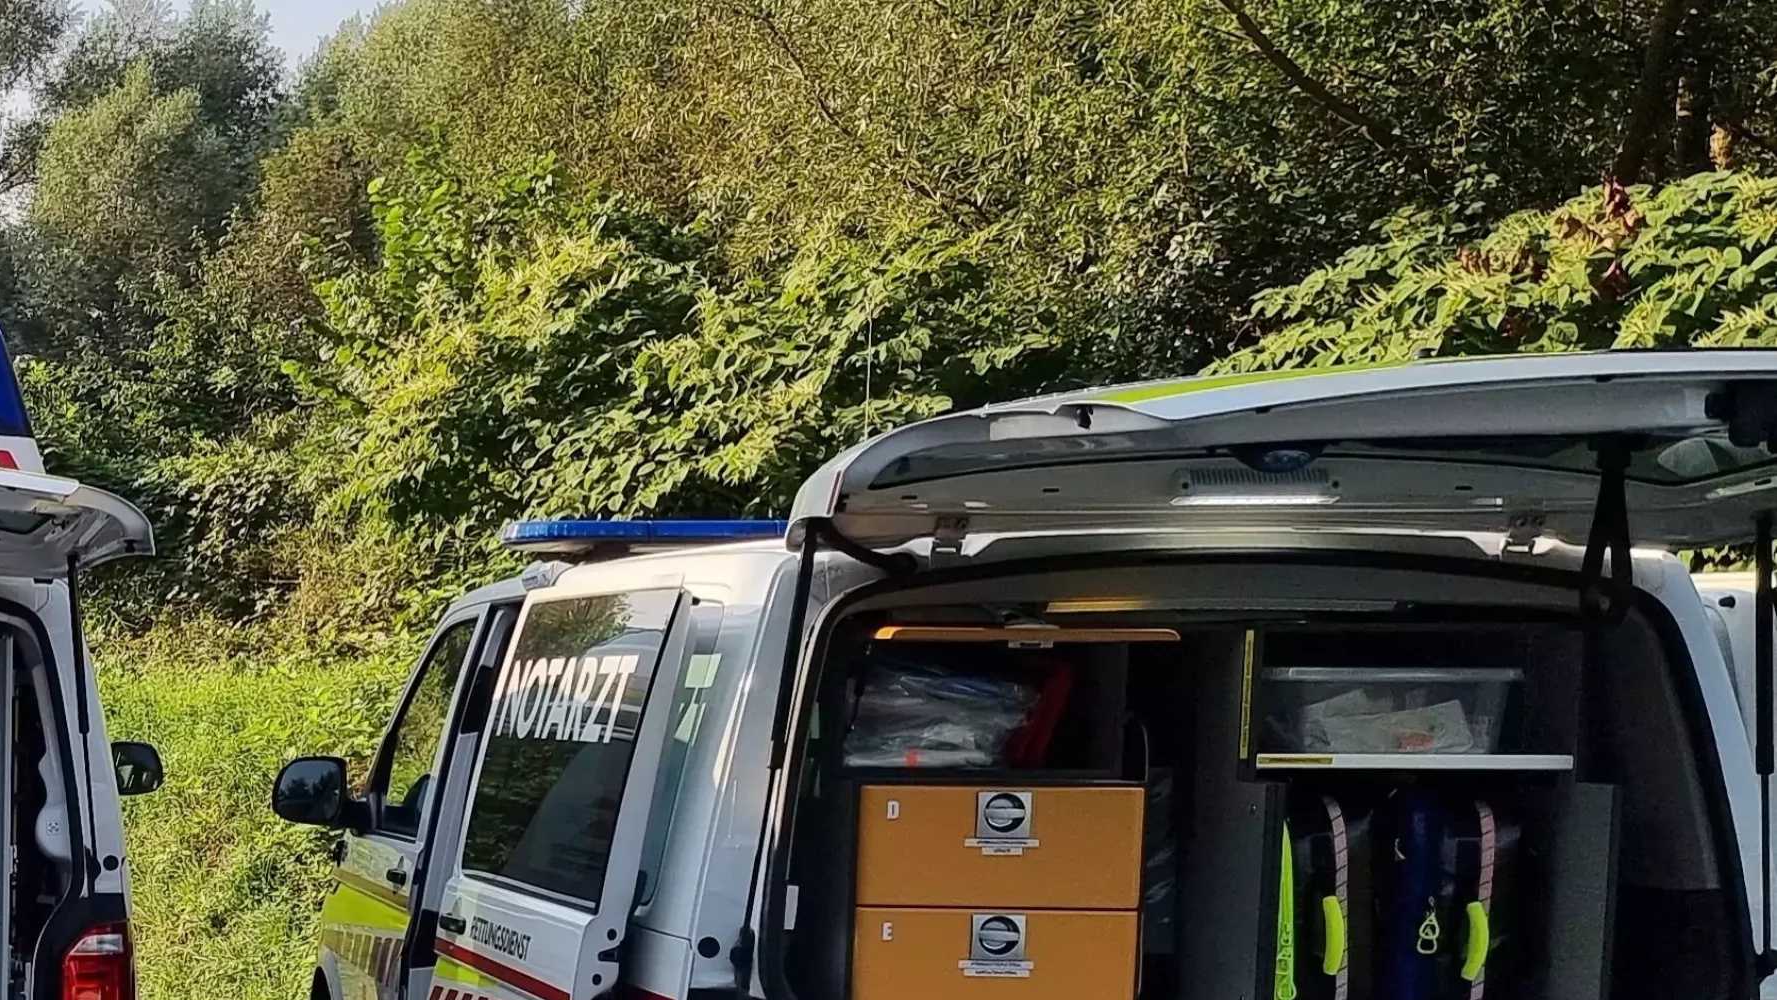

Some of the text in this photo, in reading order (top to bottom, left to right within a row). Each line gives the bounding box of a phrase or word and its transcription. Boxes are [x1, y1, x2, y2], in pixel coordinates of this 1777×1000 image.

[496, 654, 639, 744] NOTARZT
[469, 915, 532, 961] RETTUNGSDIENST
[882, 922, 893, 941] E
